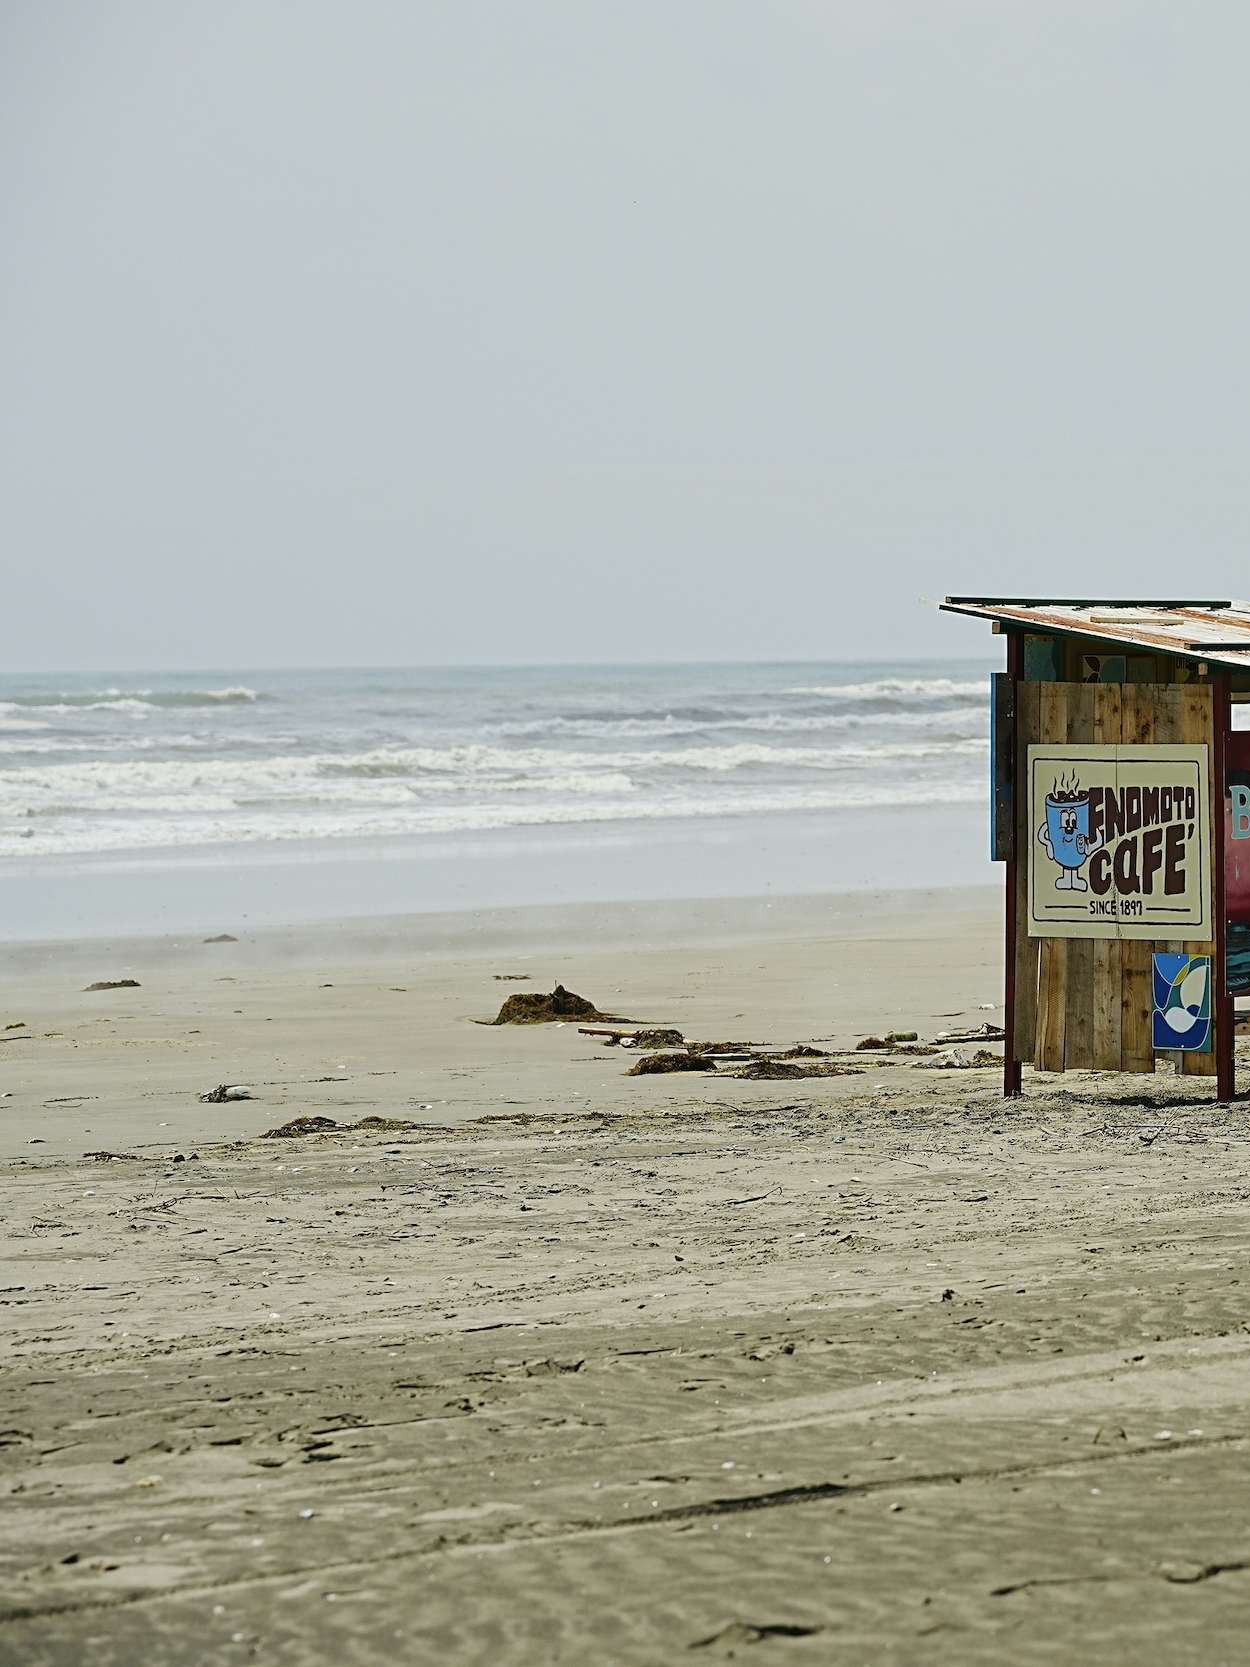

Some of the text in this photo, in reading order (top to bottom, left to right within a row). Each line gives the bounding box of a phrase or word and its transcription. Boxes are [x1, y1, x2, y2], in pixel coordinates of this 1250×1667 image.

[1089, 787, 1195, 844] ENOMOTO
[1090, 900, 1142, 915] SINCE 1897
